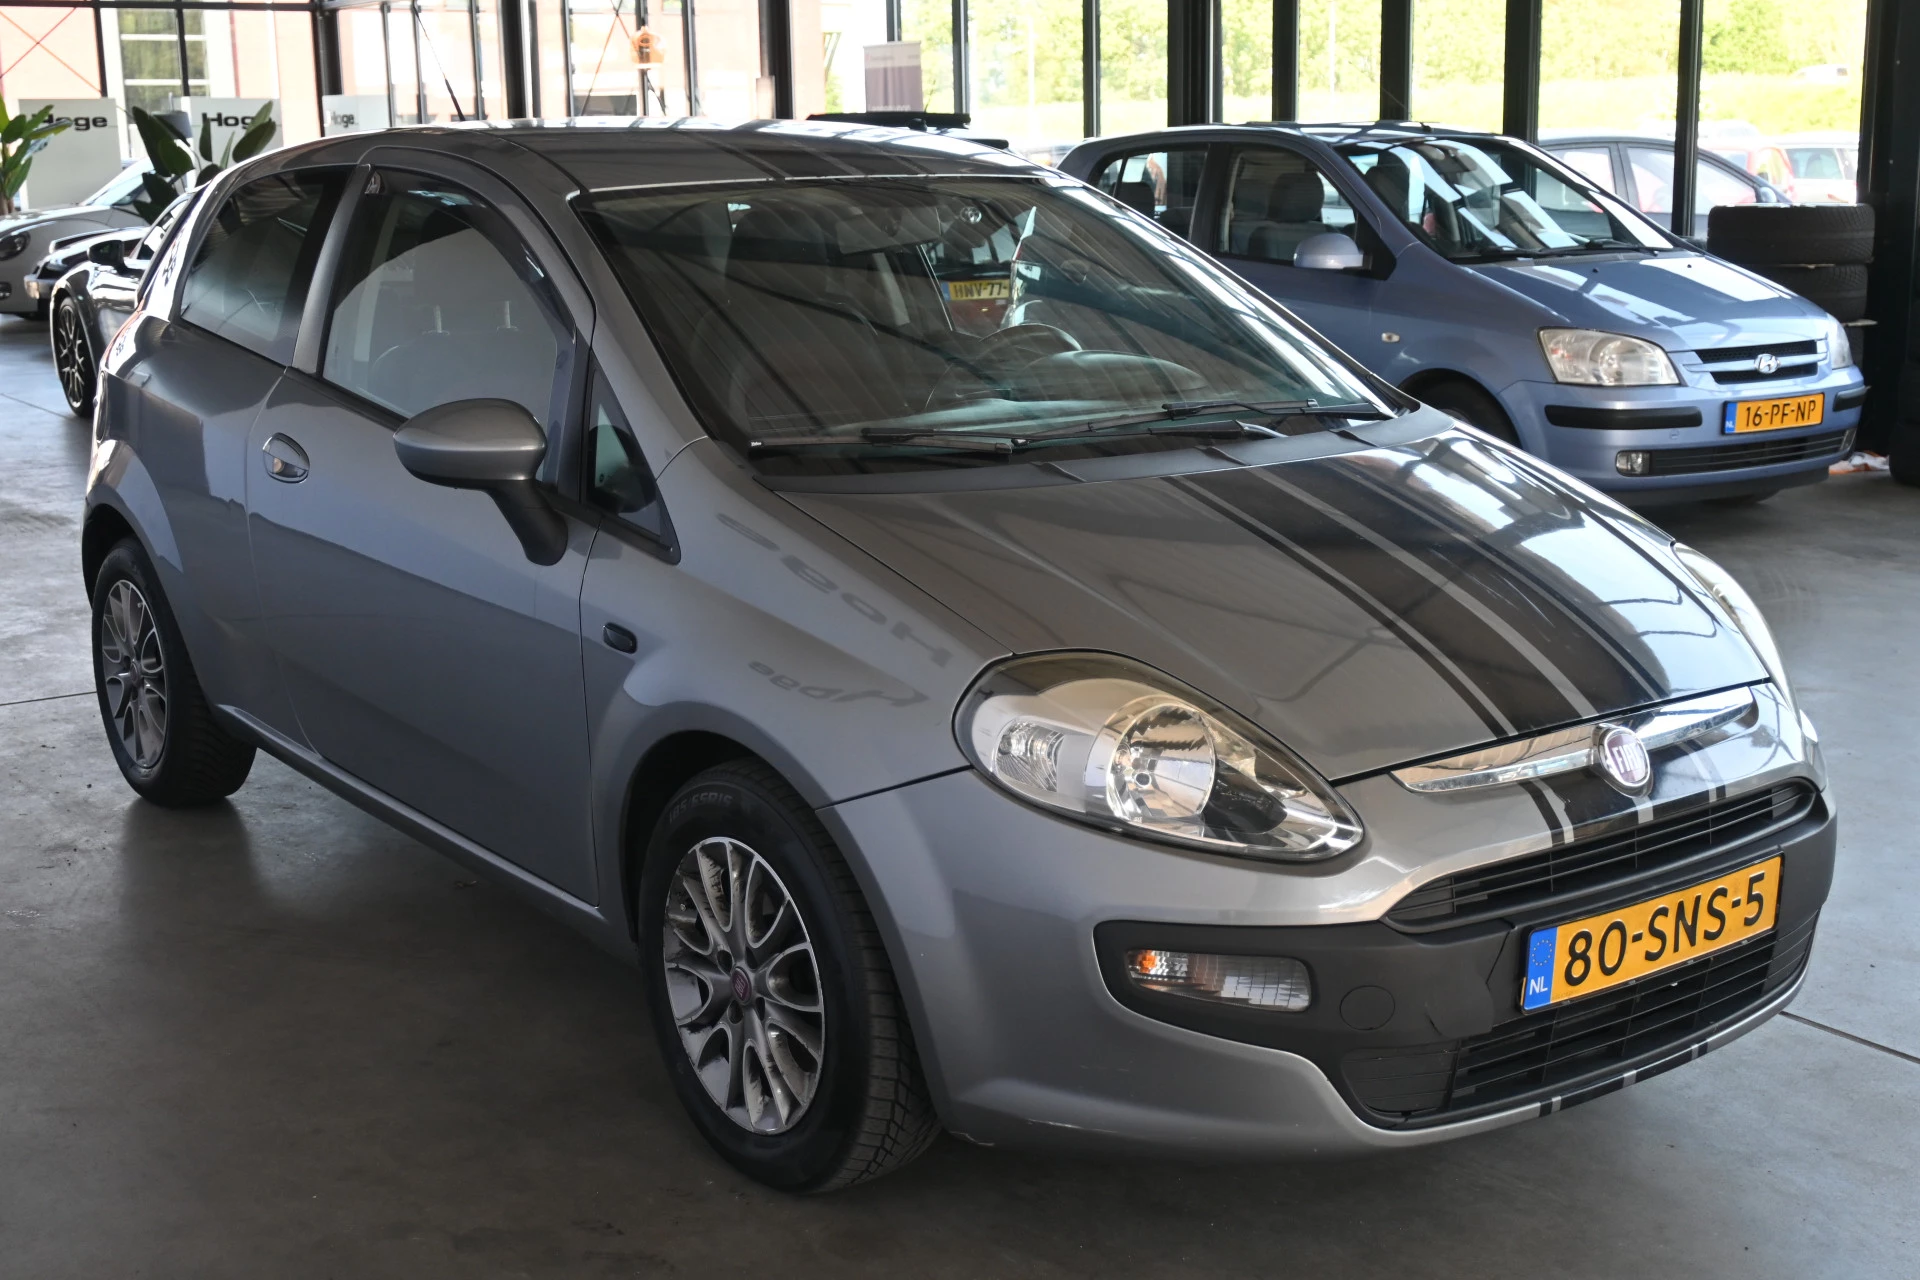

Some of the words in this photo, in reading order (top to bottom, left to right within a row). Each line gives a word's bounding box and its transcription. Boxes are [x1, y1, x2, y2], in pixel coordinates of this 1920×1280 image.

[202, 112, 270, 130] Hog
[1725, 420, 1734, 428] NL
[1744, 399, 1817, 428] 16-PF-NP
[1612, 742, 1641, 773] FIAT
[1563, 870, 1766, 987] 80-SNS-5
[1529, 975, 1549, 996] NL
